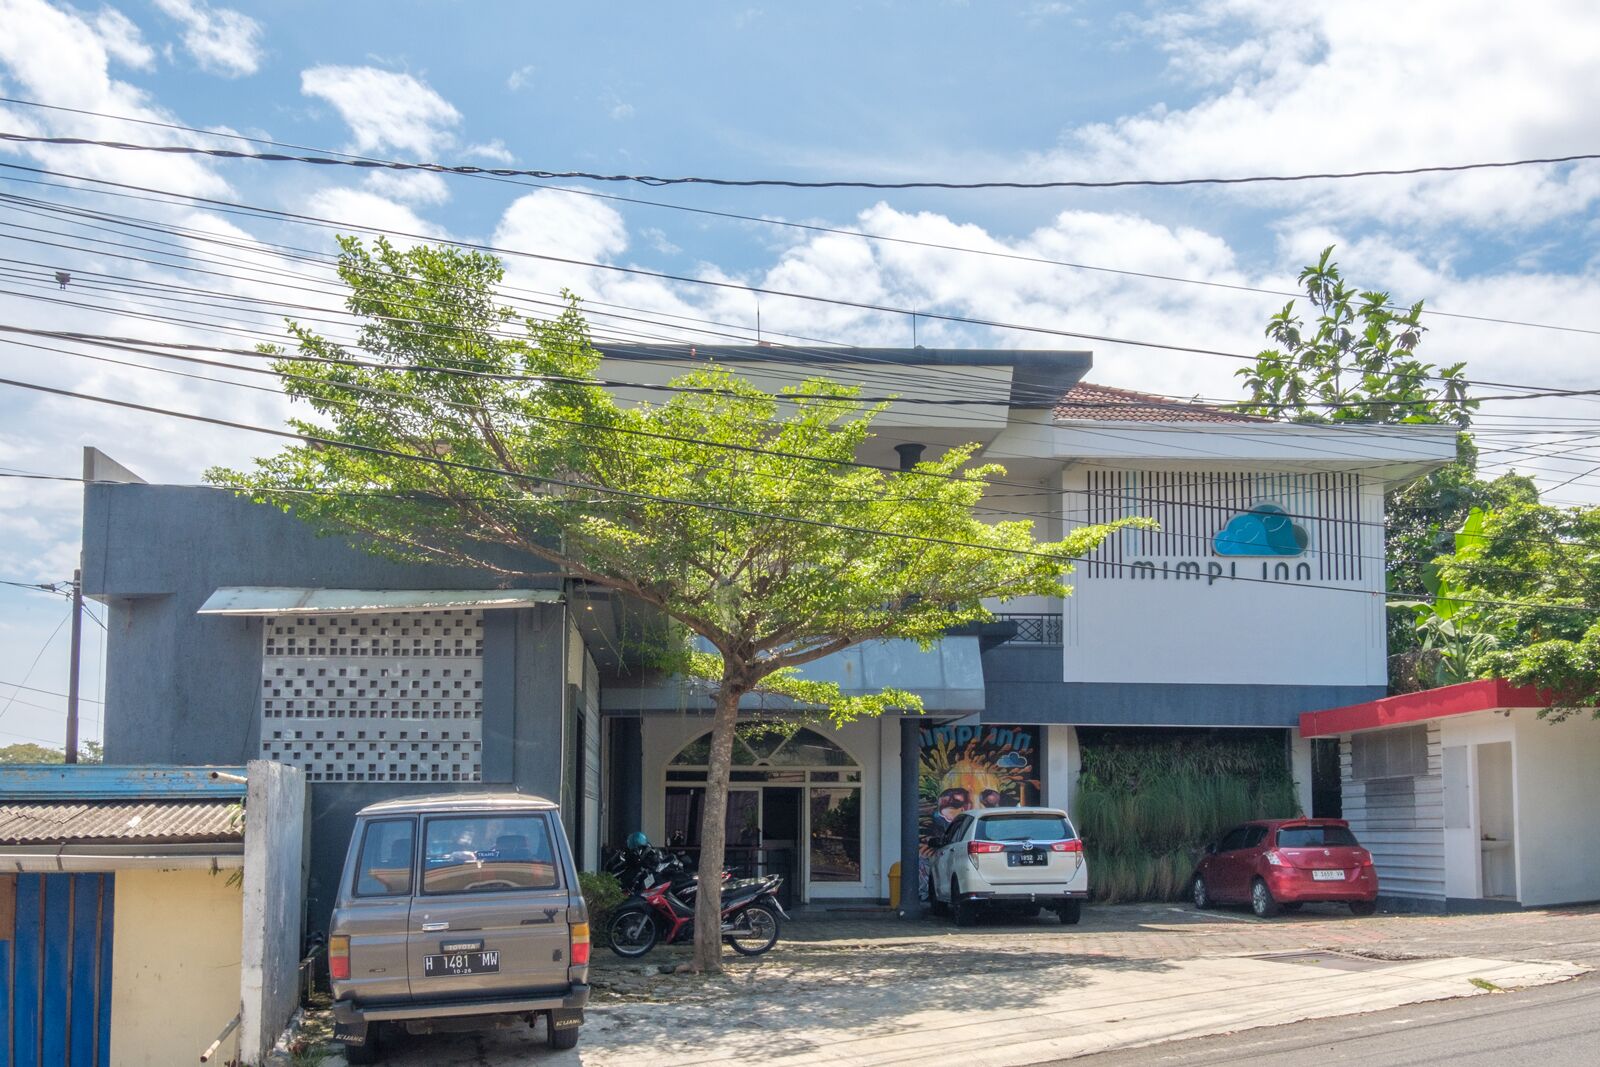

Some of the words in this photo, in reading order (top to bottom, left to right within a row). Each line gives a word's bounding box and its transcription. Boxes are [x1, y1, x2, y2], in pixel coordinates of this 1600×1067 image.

[1130, 560, 1236, 586] mimpi
[1262, 561, 1311, 580] inn
[425, 957, 433, 970] H
[443, 954, 469, 969] 1481
[482, 952, 498, 966] MW
